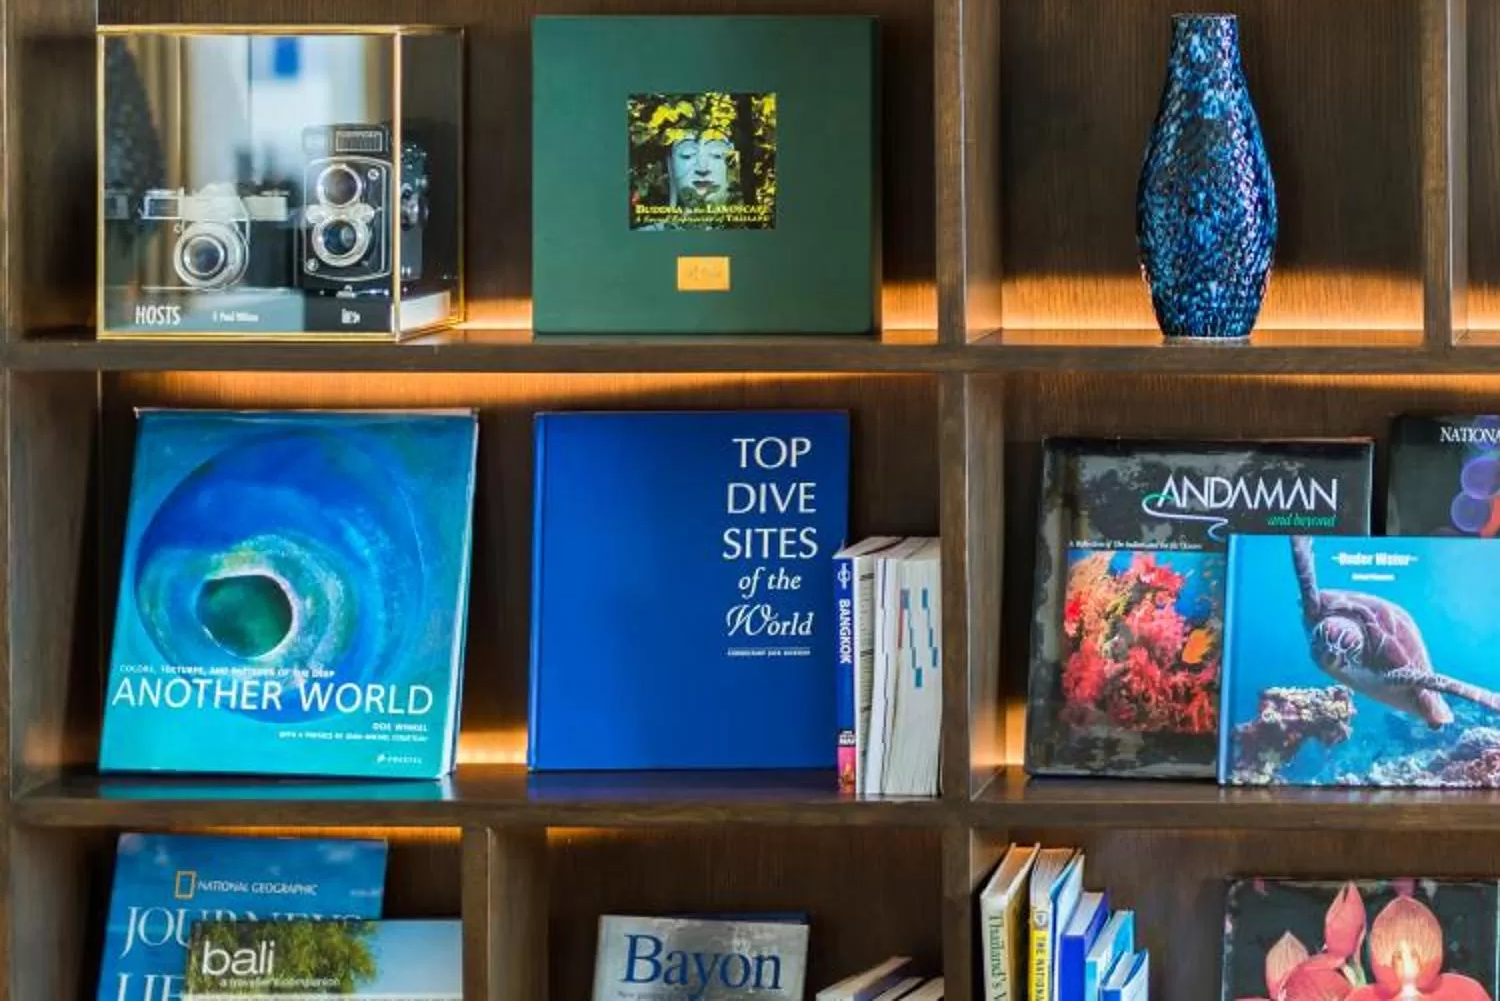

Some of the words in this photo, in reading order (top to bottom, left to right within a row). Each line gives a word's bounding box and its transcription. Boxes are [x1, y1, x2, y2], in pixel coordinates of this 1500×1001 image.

[135, 306, 181, 326] HOSTS
[732, 436, 812, 469] TOP
[727, 482, 817, 514] DIVE
[1156, 475, 1337, 510] ANDAMAN
[1267, 515, 1290, 527] and
[1292, 513, 1337, 529] beyond
[722, 527, 819, 560] SITES
[738, 566, 766, 600] of
[767, 567, 802, 590] the
[725, 604, 814, 637] World
[839, 598, 853, 664] BANGKOK
[112, 678, 282, 712] ANOTHER
[299, 682, 433, 714] WORLD
[197, 880, 249, 892] NATIONAL
[251, 882, 319, 896] GEOGRAPHIC
[201, 939, 276, 976] bali
[619, 934, 782, 1001] Bayon
